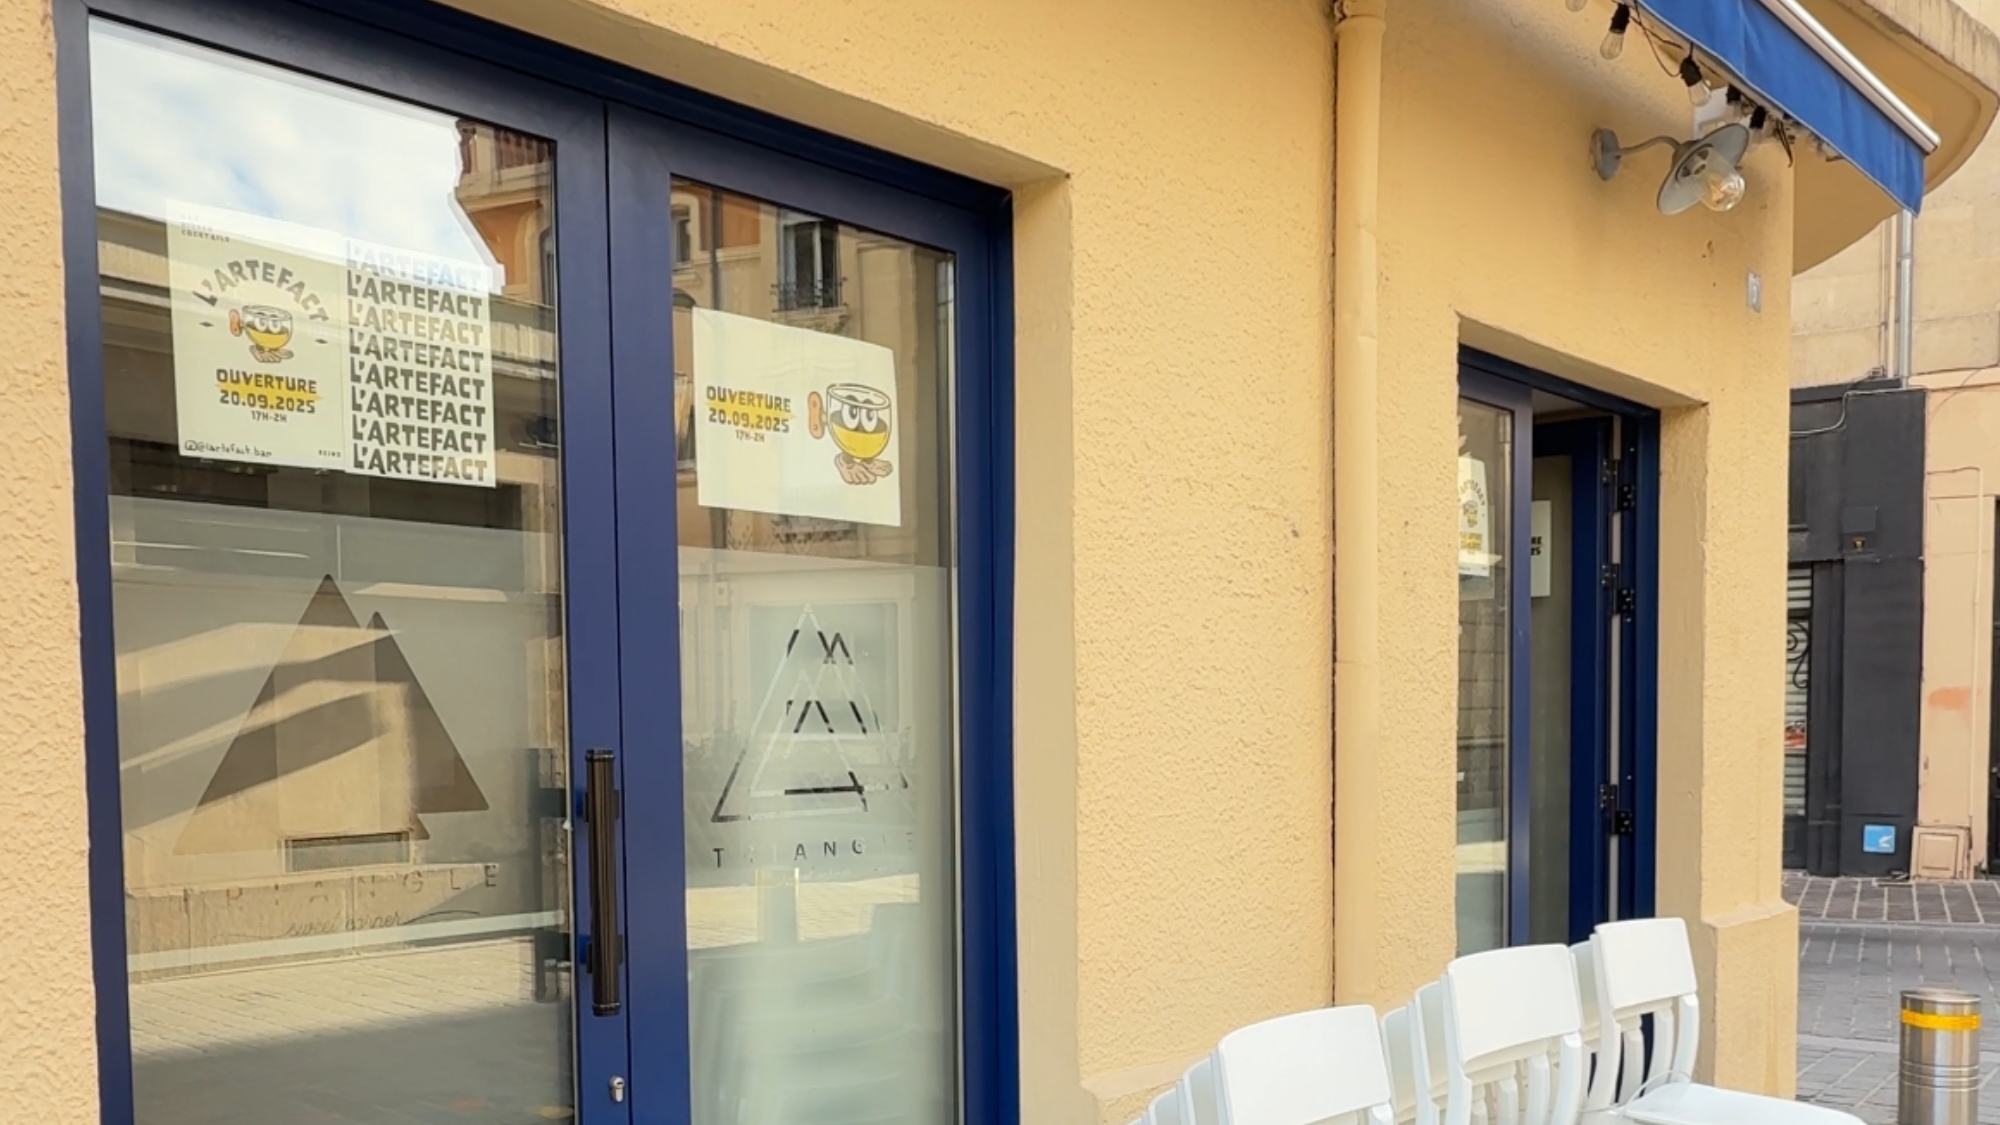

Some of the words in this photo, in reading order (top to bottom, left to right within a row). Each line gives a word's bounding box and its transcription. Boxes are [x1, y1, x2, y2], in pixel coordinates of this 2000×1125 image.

[192, 259, 330, 322] L'ARTEFACT
[347, 269, 482, 319] L'ARTEFACT
[348, 298, 484, 346] L'ARTEFACT
[349, 327, 484, 373] L'ARTEFACT
[216, 368, 317, 394] OUVERTURE
[350, 356, 485, 400] L'ARTEFACT
[219, 389, 316, 414] 20.09.2025
[251, 410, 288, 423] 17H-2H
[352, 385, 486, 427] L'ARTEFACT
[706, 385, 791, 413] OUVERTURE
[352, 414, 487, 454] L'ARTEFACT
[708, 407, 790, 434] 20.09.2025
[735, 429, 765, 443] 17H-2H
[353, 443, 488, 482] L'ARTEFACT
